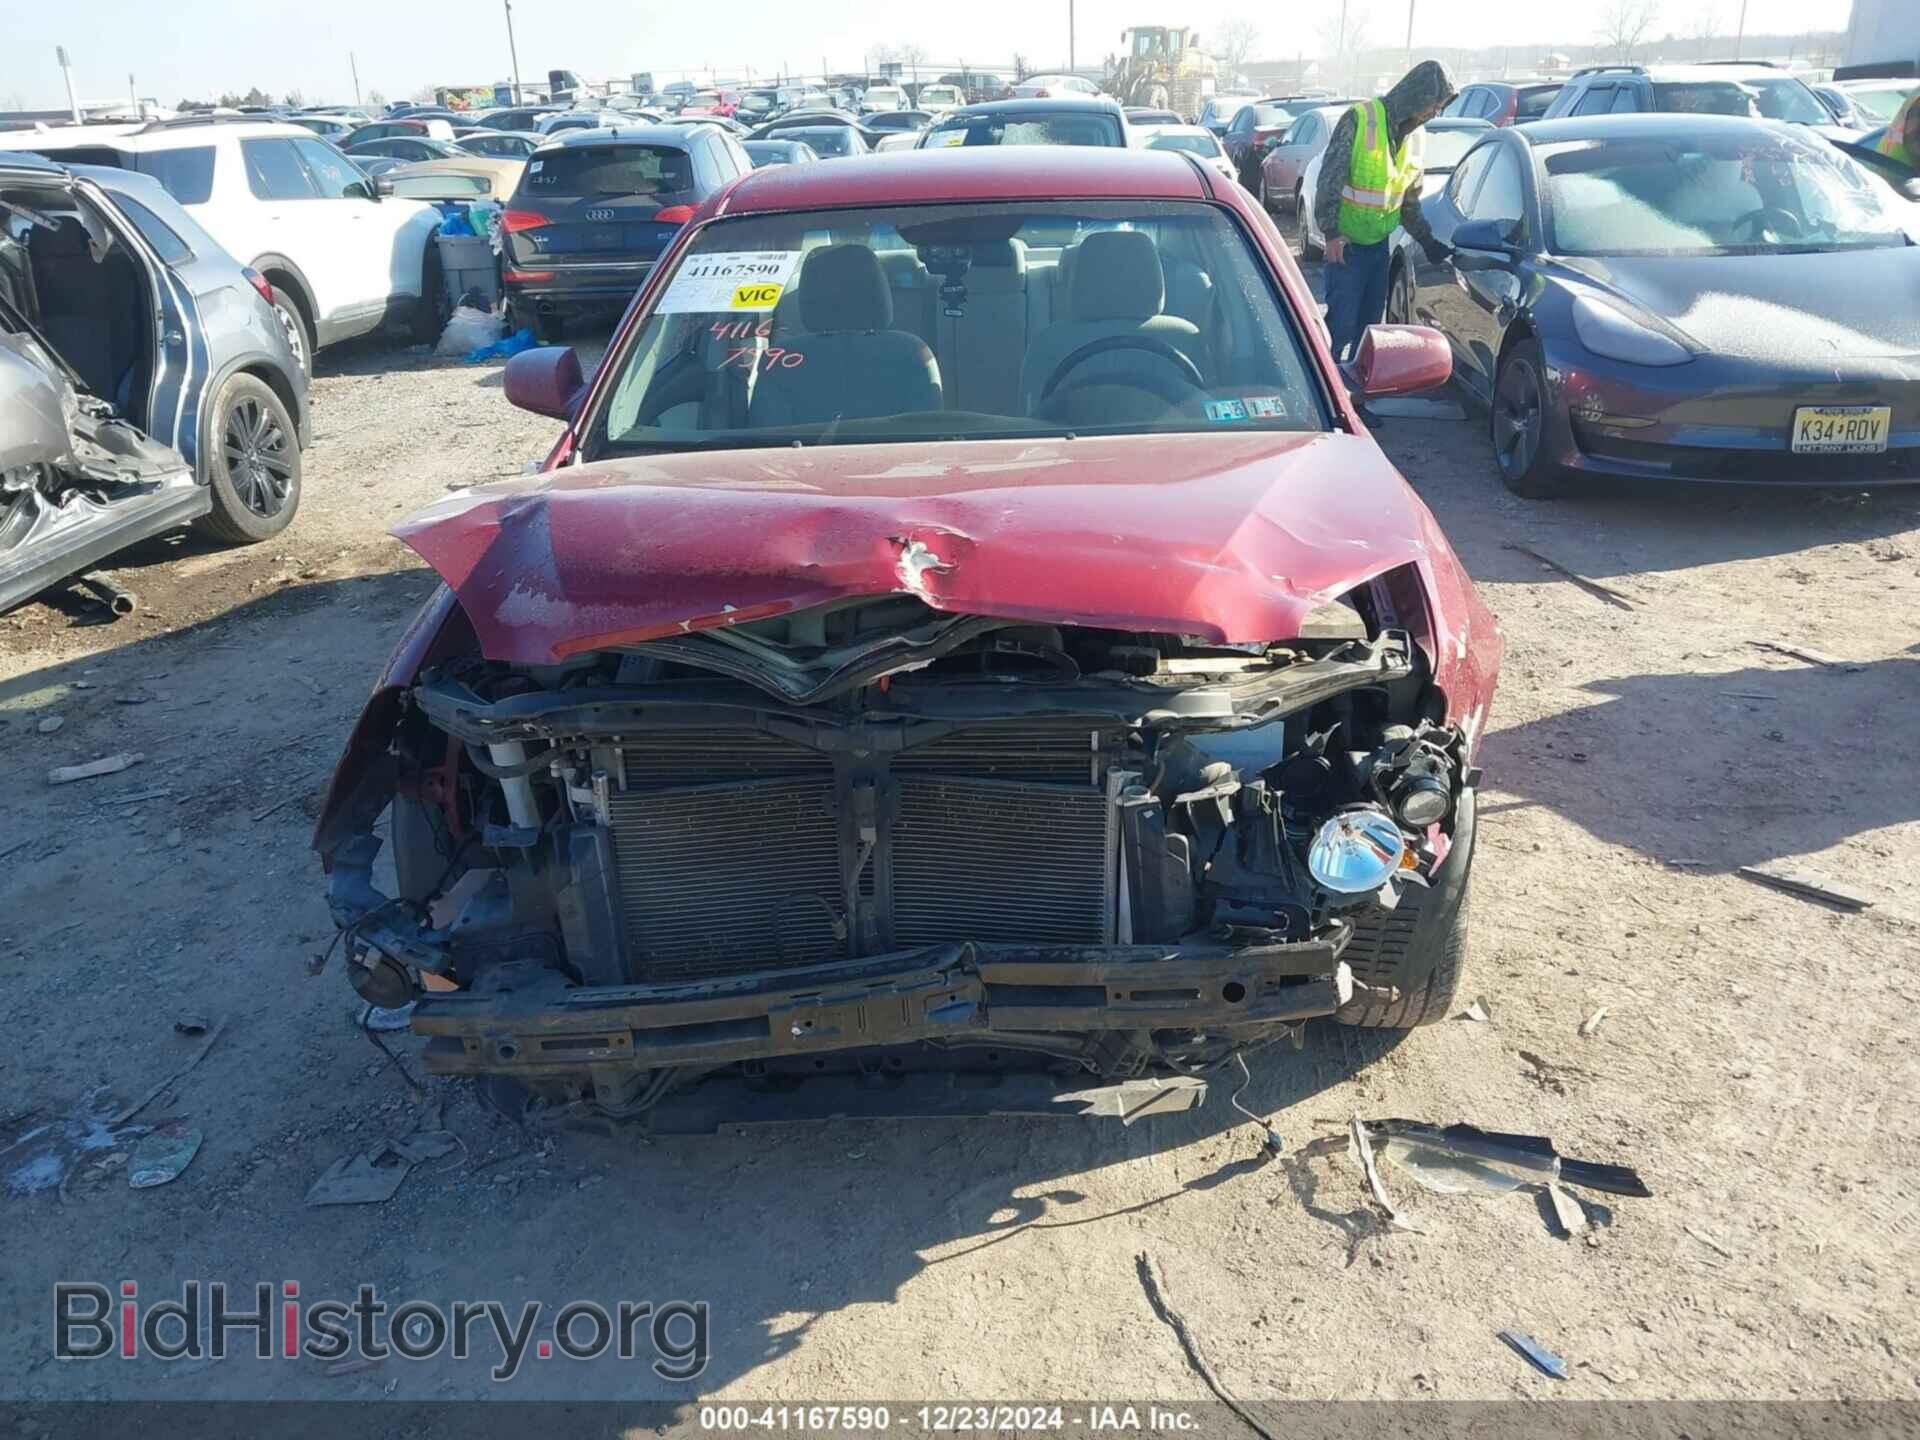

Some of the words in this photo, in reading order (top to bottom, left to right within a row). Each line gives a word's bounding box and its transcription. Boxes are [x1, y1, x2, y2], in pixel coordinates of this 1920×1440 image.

[688, 264, 780, 278] 41167590
[738, 288, 777, 303] VIC
[1800, 420, 1835, 441] K34
